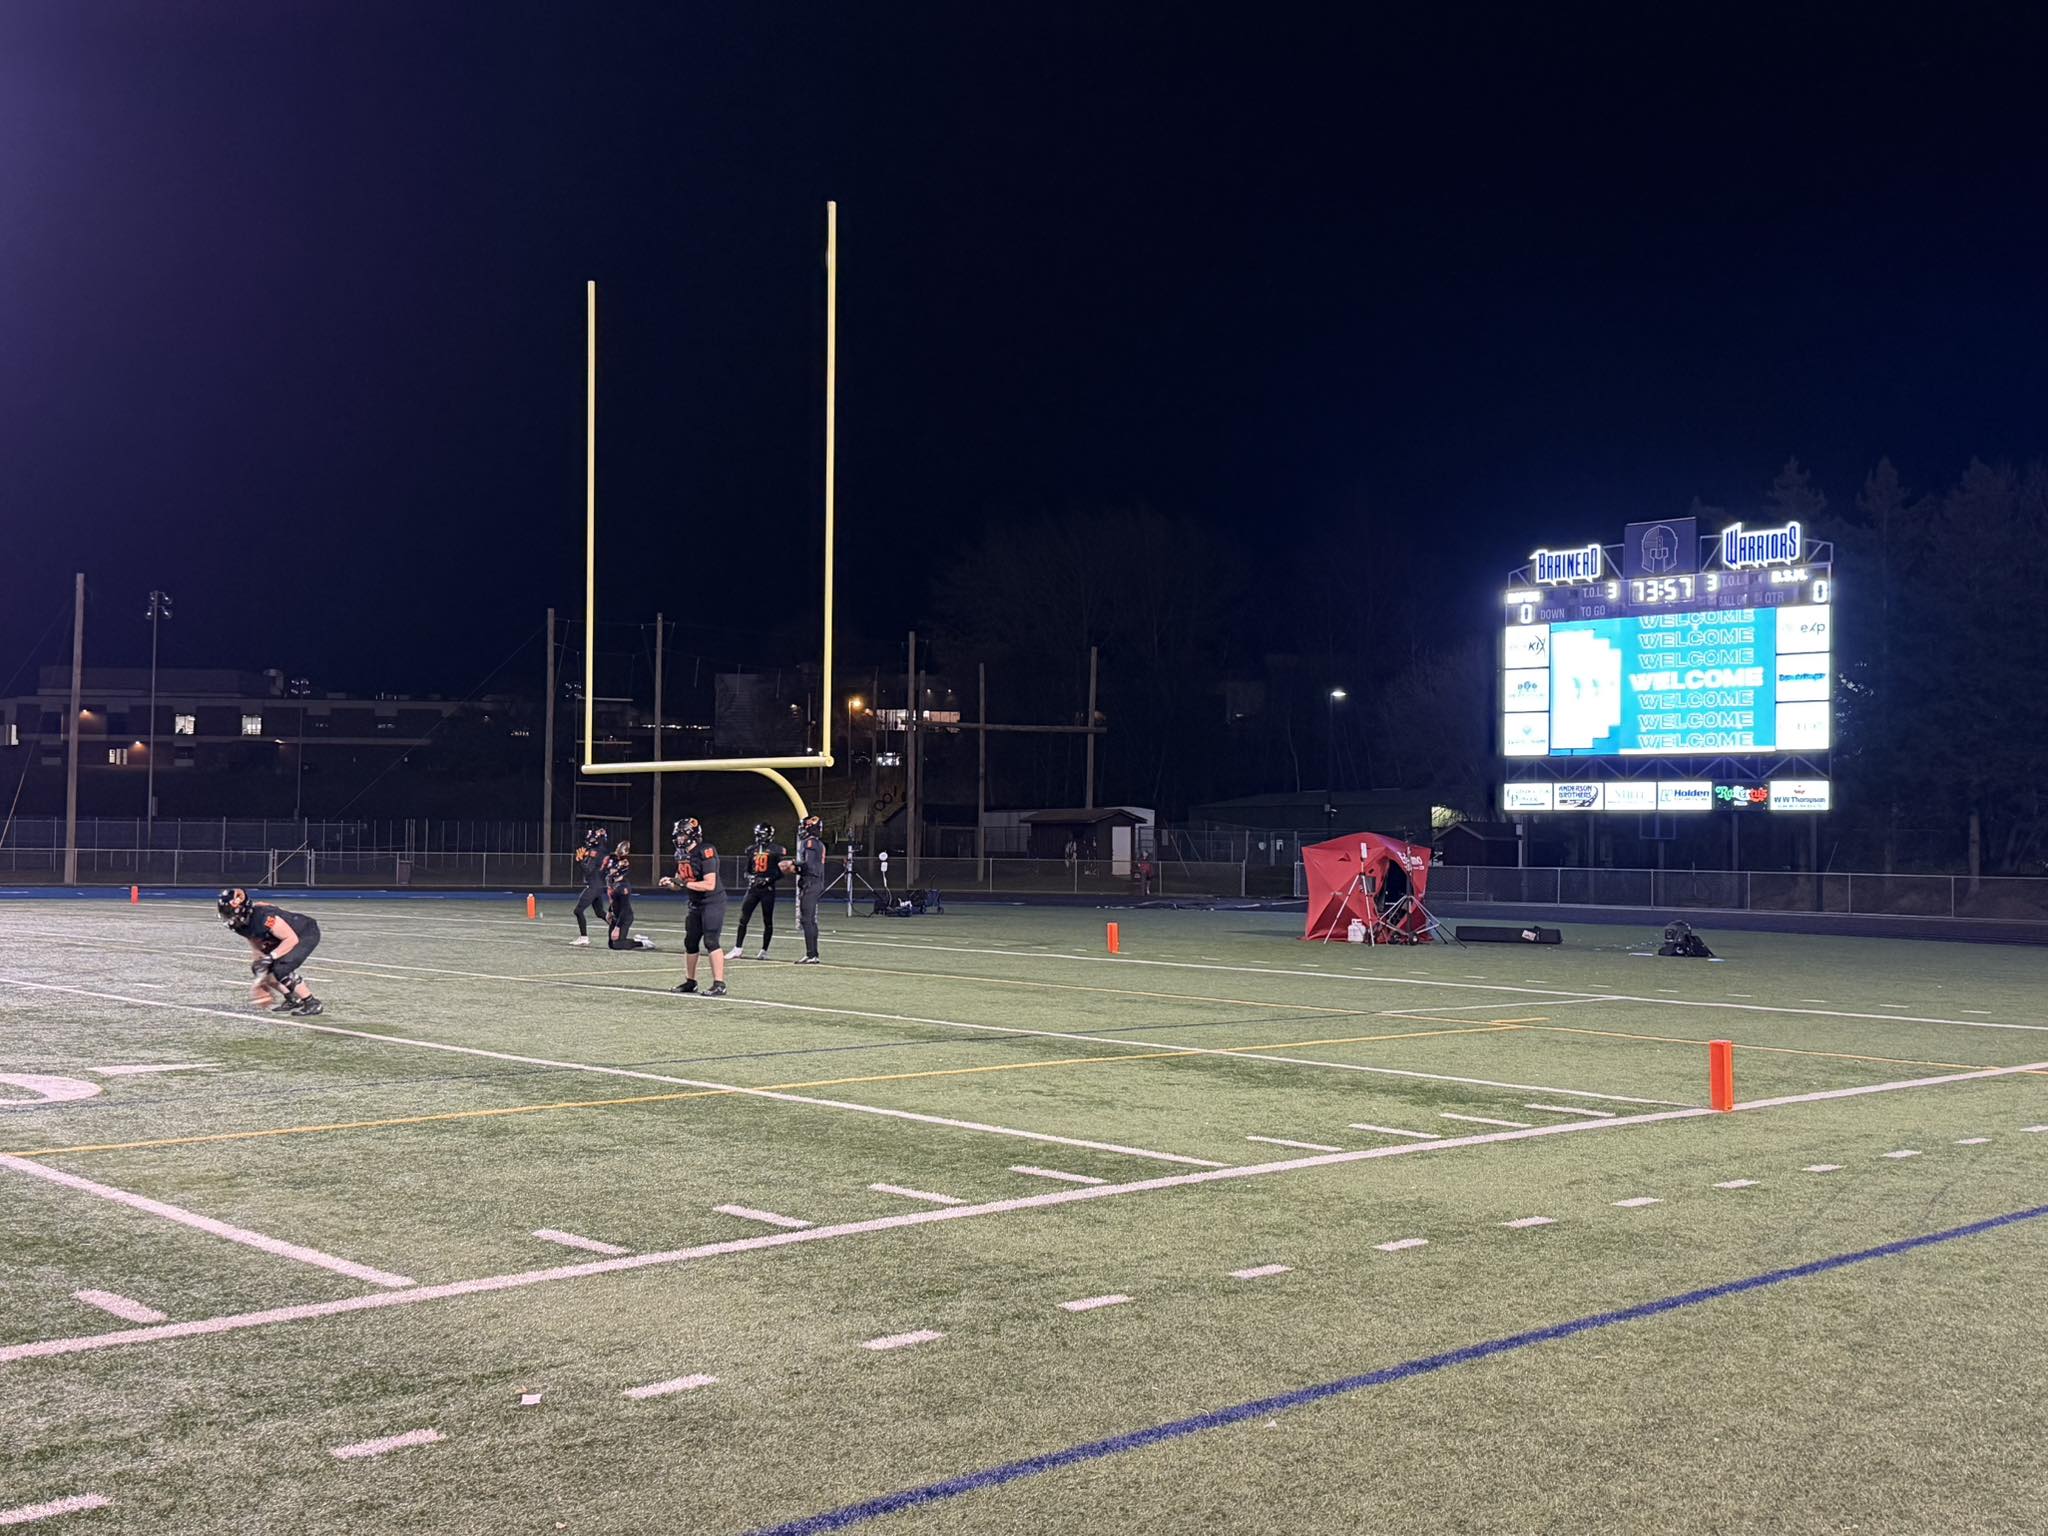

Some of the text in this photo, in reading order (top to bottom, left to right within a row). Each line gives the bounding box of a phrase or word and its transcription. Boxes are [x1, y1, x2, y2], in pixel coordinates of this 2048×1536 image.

[1725, 525, 1797, 566] WARRIORS
[1538, 547, 1598, 580] BRAINERD
[1607, 582, 1618, 599] 3
[1706, 573, 1717, 591] 3
[1812, 579, 1828, 603] 0
[1520, 603, 1533, 624] 0
[1540, 608, 1565, 620] DOWN
[1581, 605, 1606, 617] TO GO
[1639, 609, 1755, 628] WELCOME
[1640, 629, 1754, 649] WELCOME
[1639, 648, 1754, 668] WELCOME
[1630, 667, 1764, 691] WELCOME
[1639, 691, 1754, 710] WELCOME
[1640, 711, 1754, 731] WELCOME
[1639, 731, 1754, 749] WELCOME
[1674, 788, 1710, 797] Holden
[752, 852, 769, 873] 19
